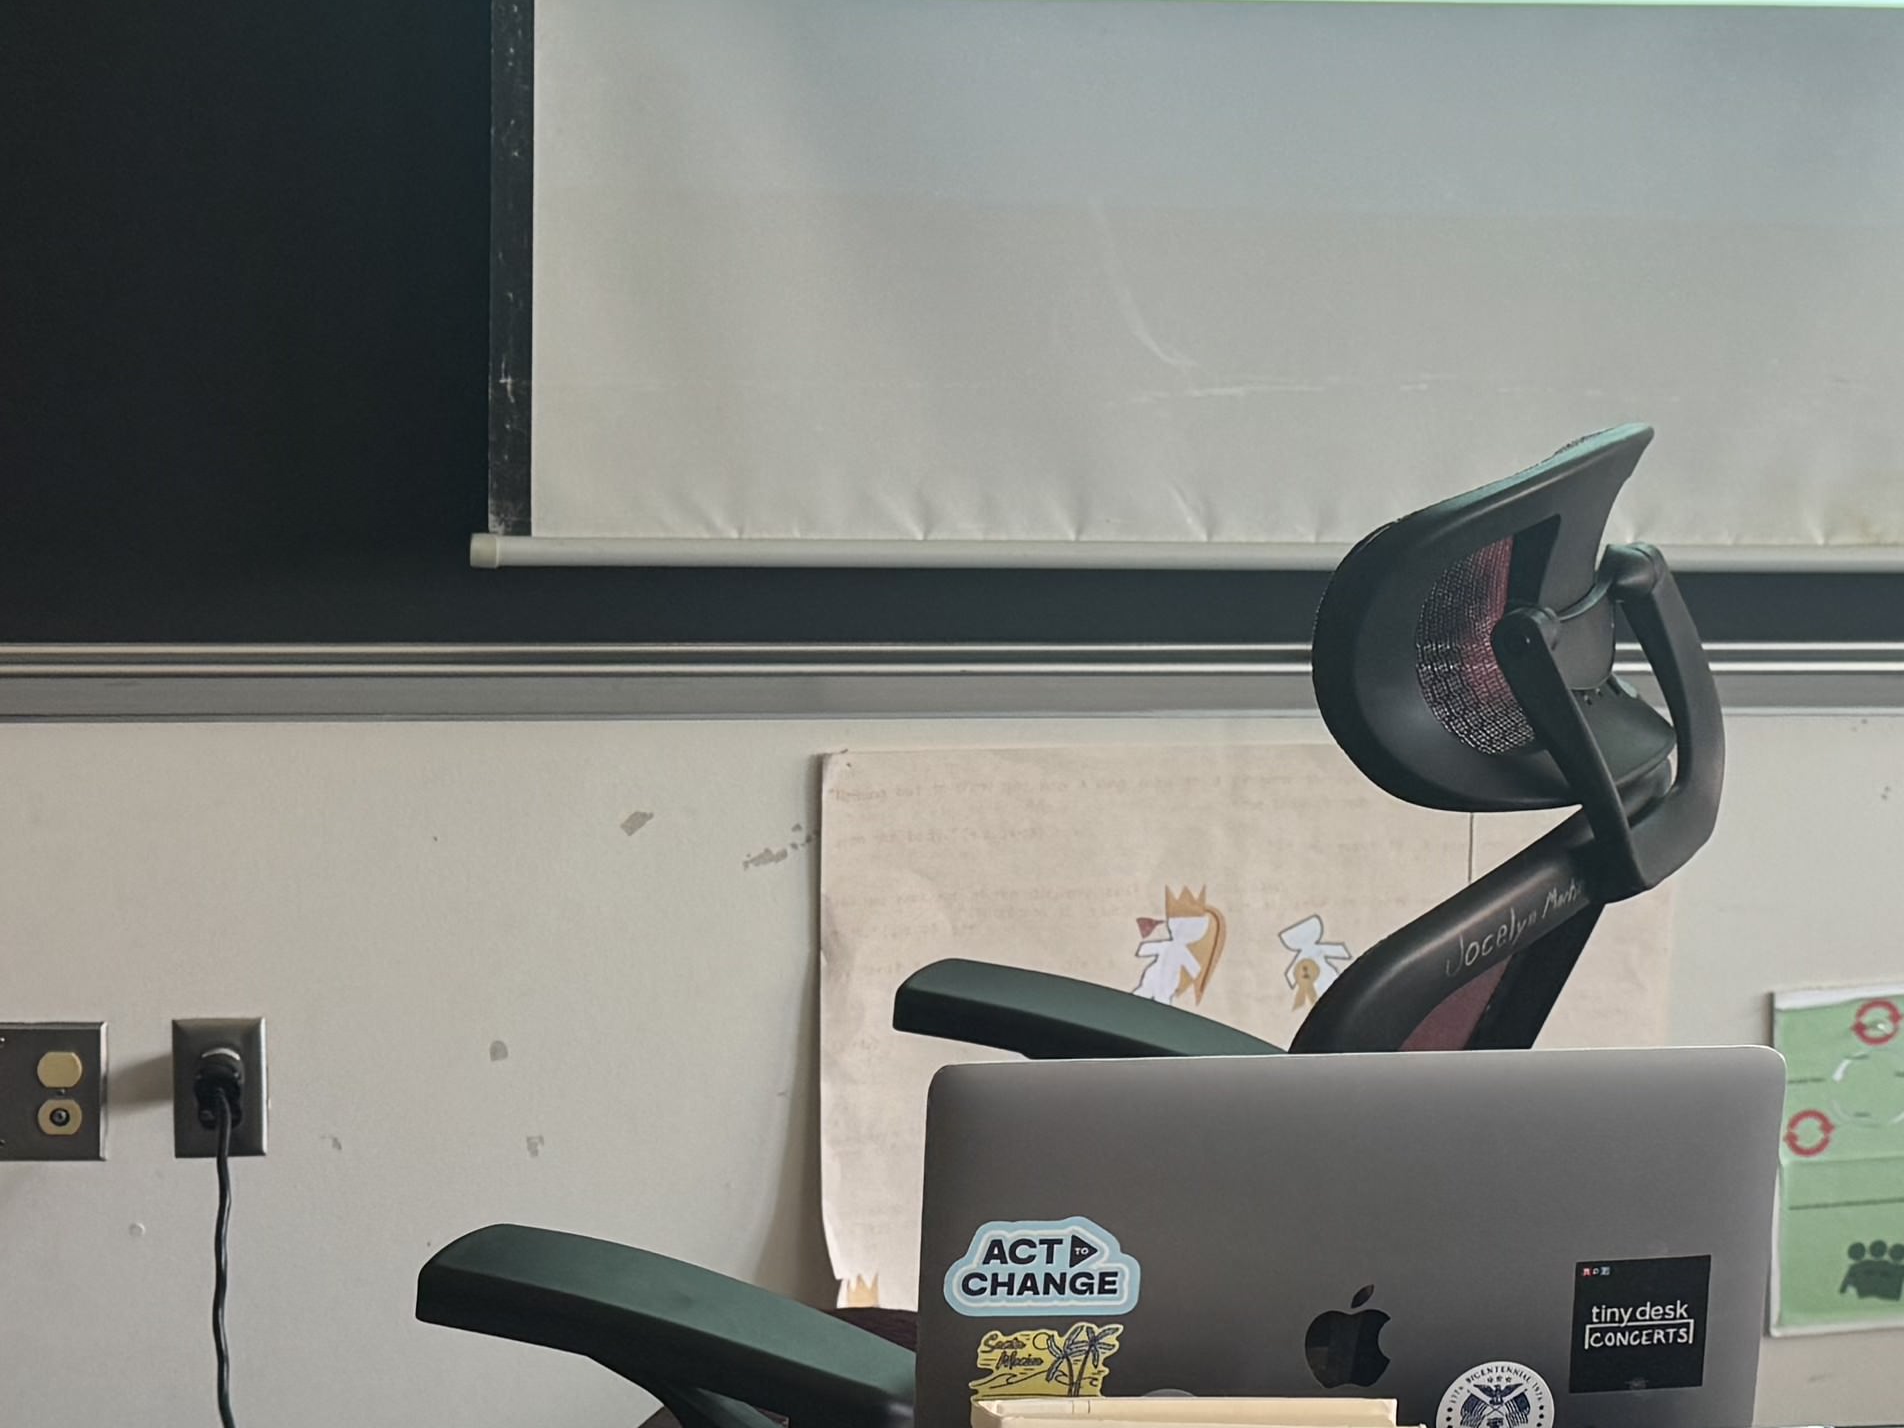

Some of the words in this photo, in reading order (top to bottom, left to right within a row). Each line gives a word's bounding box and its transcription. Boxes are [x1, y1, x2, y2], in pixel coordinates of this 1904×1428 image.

[1445, 907, 1538, 977] Jocelyn
[982, 1238, 1064, 1266] ACT
[1074, 1247, 1090, 1255] TO
[961, 1271, 1119, 1297] CHANGE
[1591, 1305, 1633, 1327] tiny
[1636, 1300, 1689, 1322] desk
[1589, 1327, 1689, 1348] CONCERTS
[1464, 1365, 1532, 1384] BICENTENNIAL
